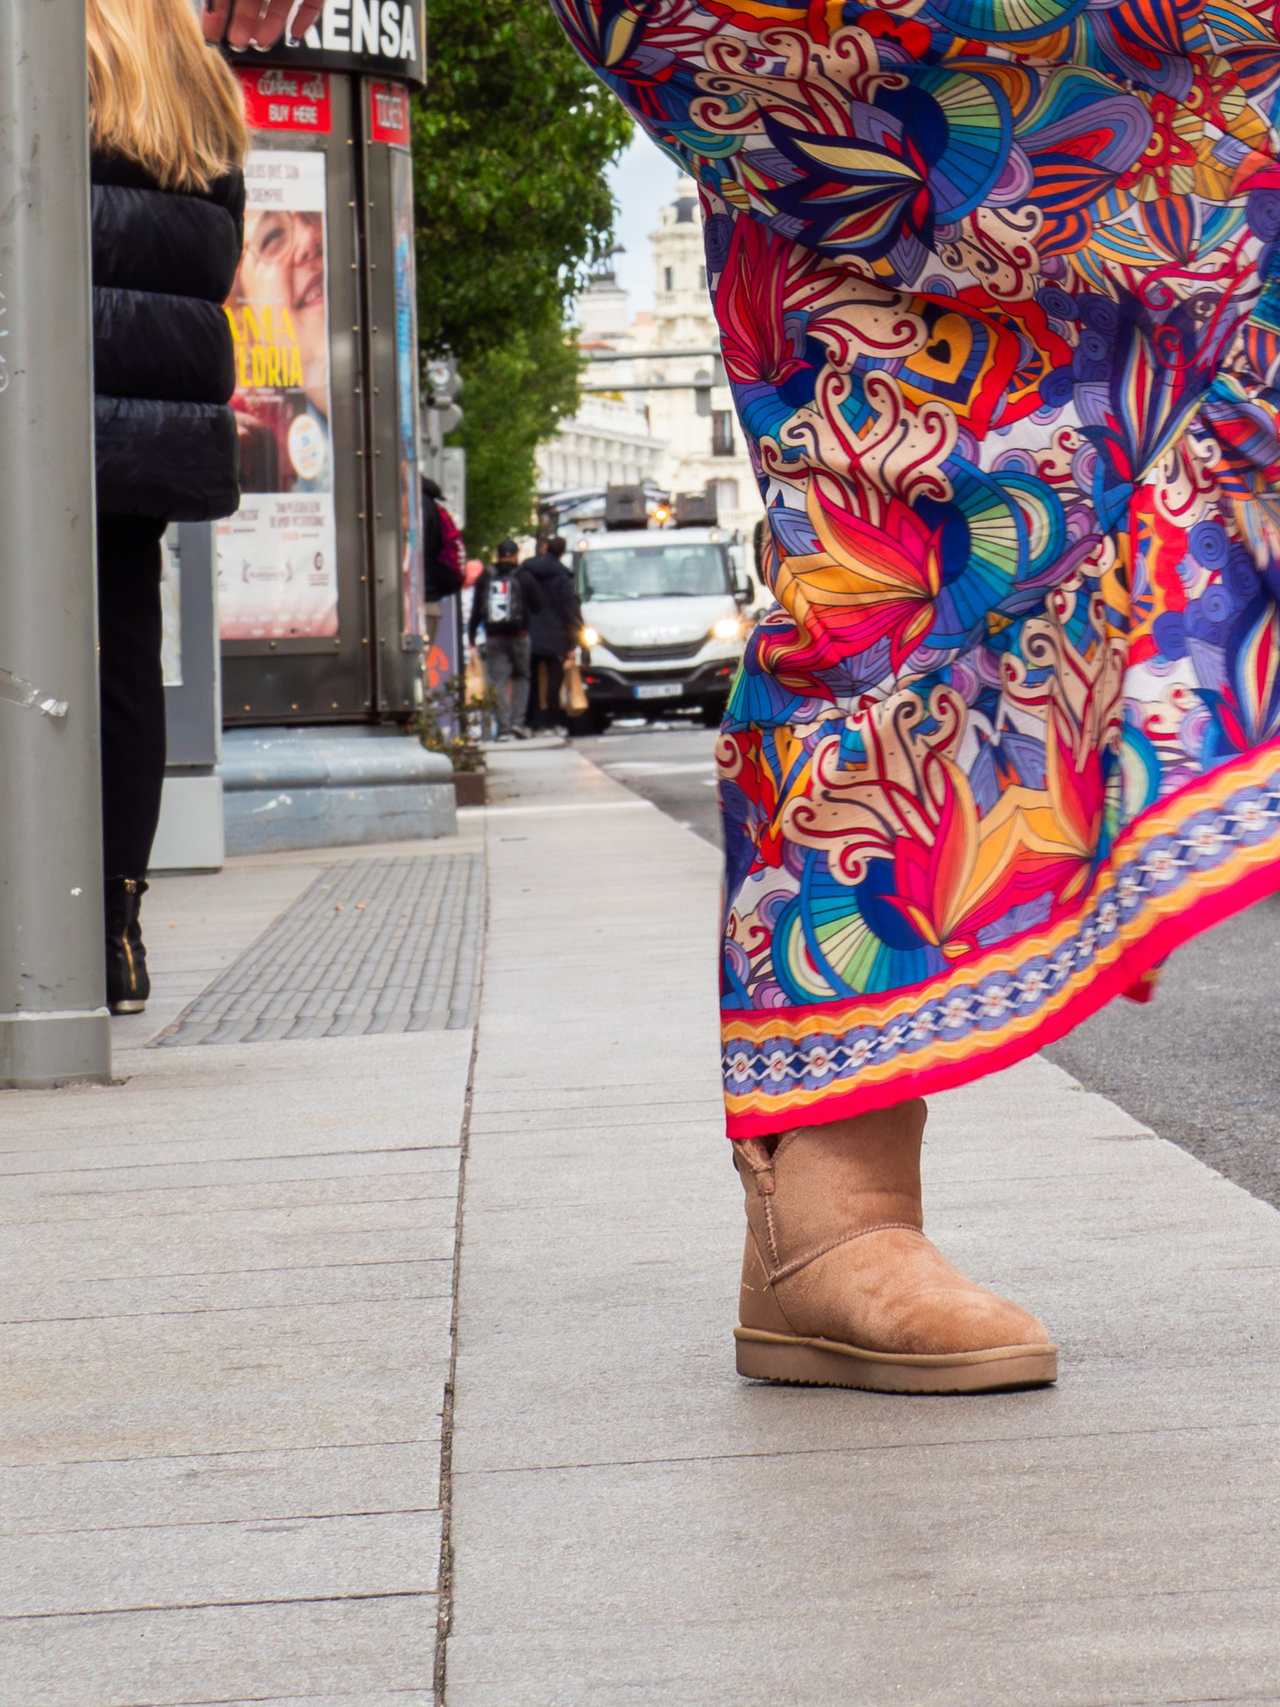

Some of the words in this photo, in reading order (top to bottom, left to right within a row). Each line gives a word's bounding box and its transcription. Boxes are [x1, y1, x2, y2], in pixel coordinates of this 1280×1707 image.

[268, 103, 289, 122] BUY
[293, 105, 318, 125] HERE
[238, 345, 304, 387] LORIA
